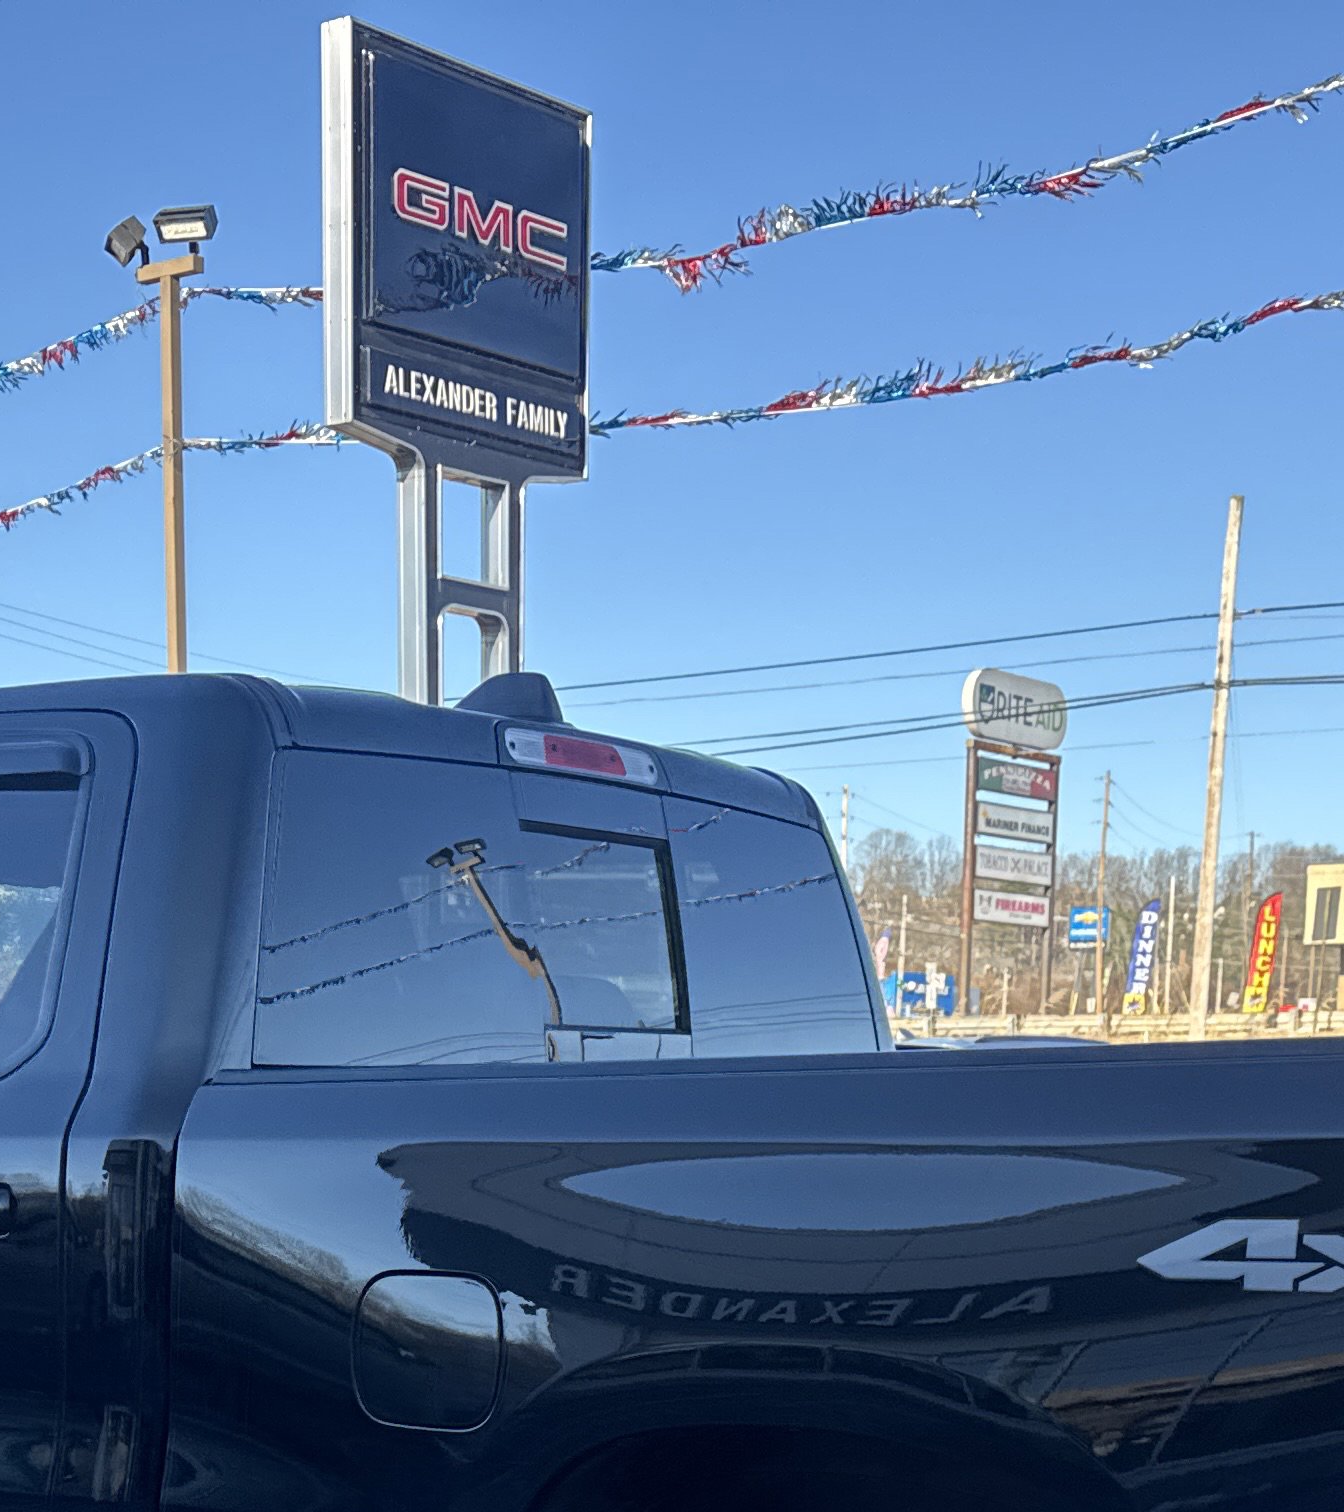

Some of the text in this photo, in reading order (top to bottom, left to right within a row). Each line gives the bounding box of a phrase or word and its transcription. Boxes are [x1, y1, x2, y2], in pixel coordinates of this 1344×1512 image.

[392, 168, 568, 271] GMC
[383, 364, 568, 440] ALEXANDER FAMILY
[997, 690, 1063, 732] RITE AID
[985, 817, 1019, 833] MARINER
[1131, 910, 1159, 995] DINNER
[1252, 905, 1277, 988] LUNCH
